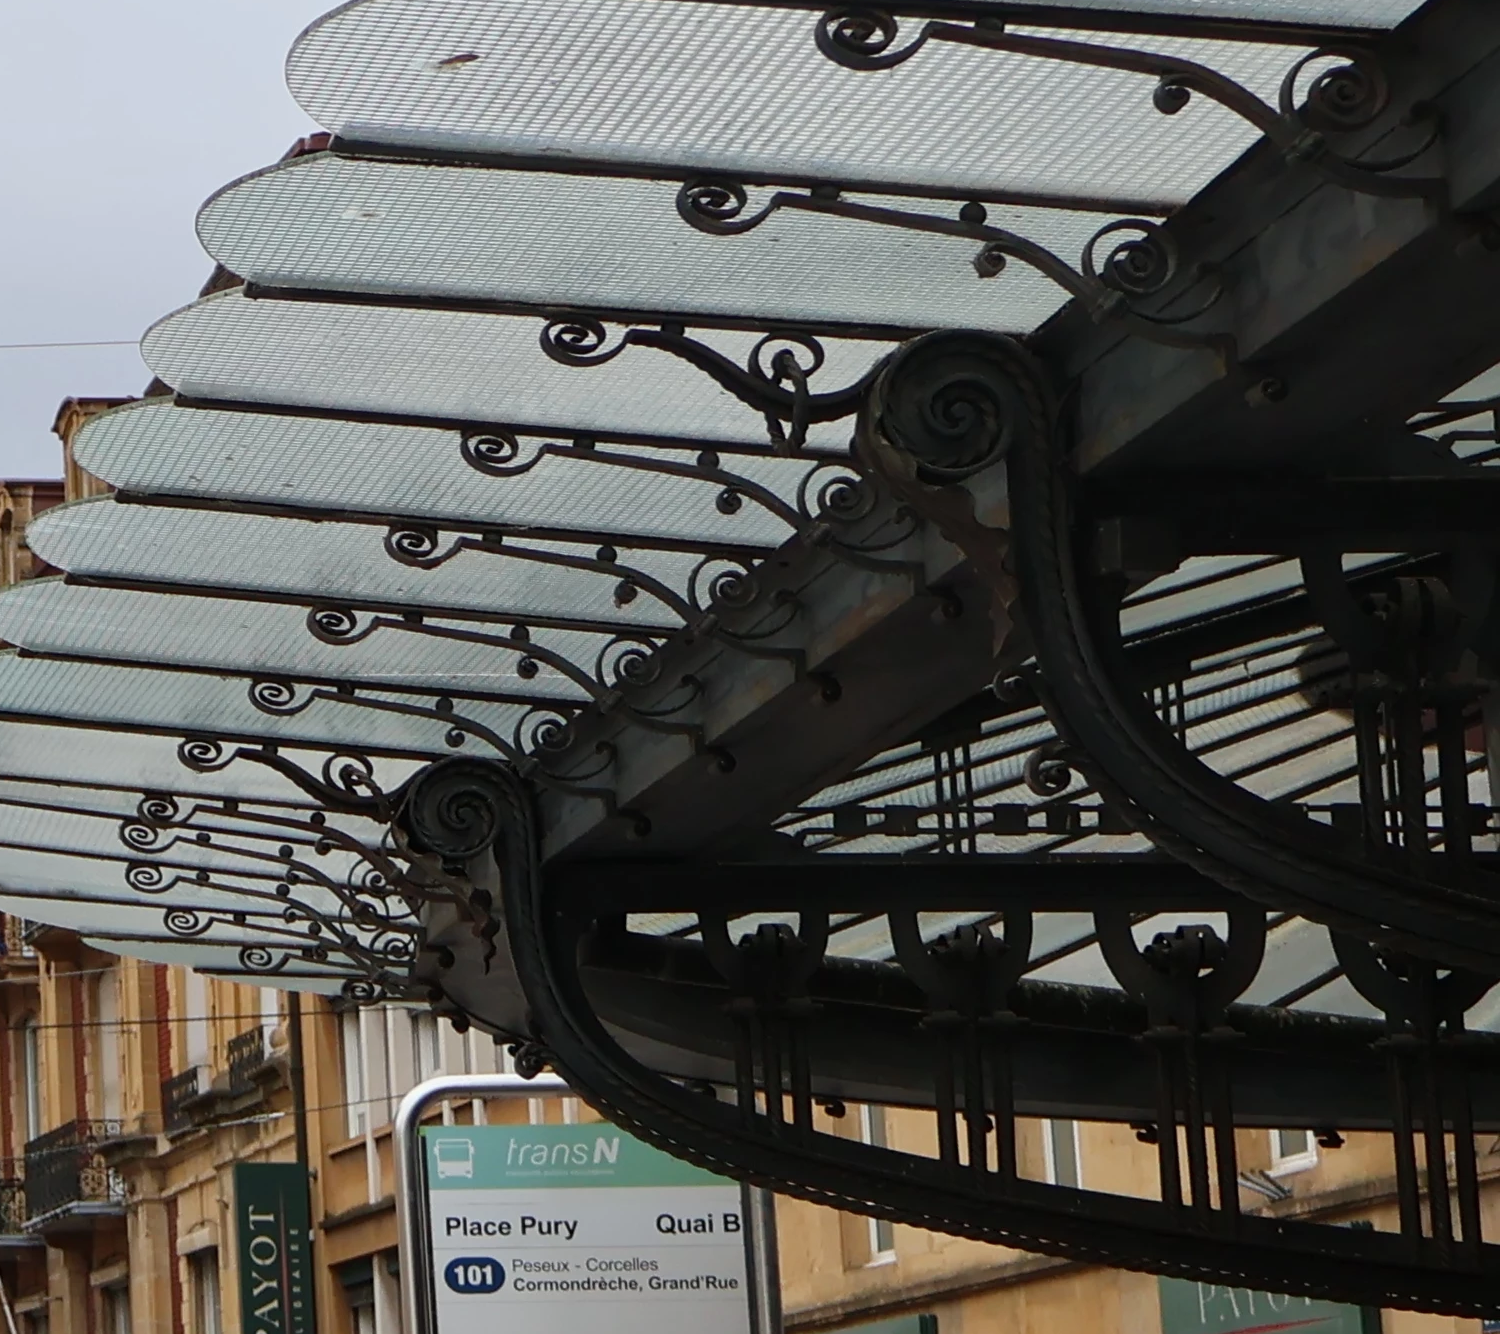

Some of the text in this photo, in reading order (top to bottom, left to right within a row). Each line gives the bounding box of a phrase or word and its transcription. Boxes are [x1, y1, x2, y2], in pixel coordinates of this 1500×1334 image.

[445, 1216, 578, 1240] Place Pury
[656, 1213, 741, 1235] Quai B
[454, 1264, 493, 1286] 101
[512, 1258, 570, 1273] Peseux
[586, 1257, 659, 1272] Corcelles
[513, 1275, 739, 1292] Cormondrèche, Grand'Rue
